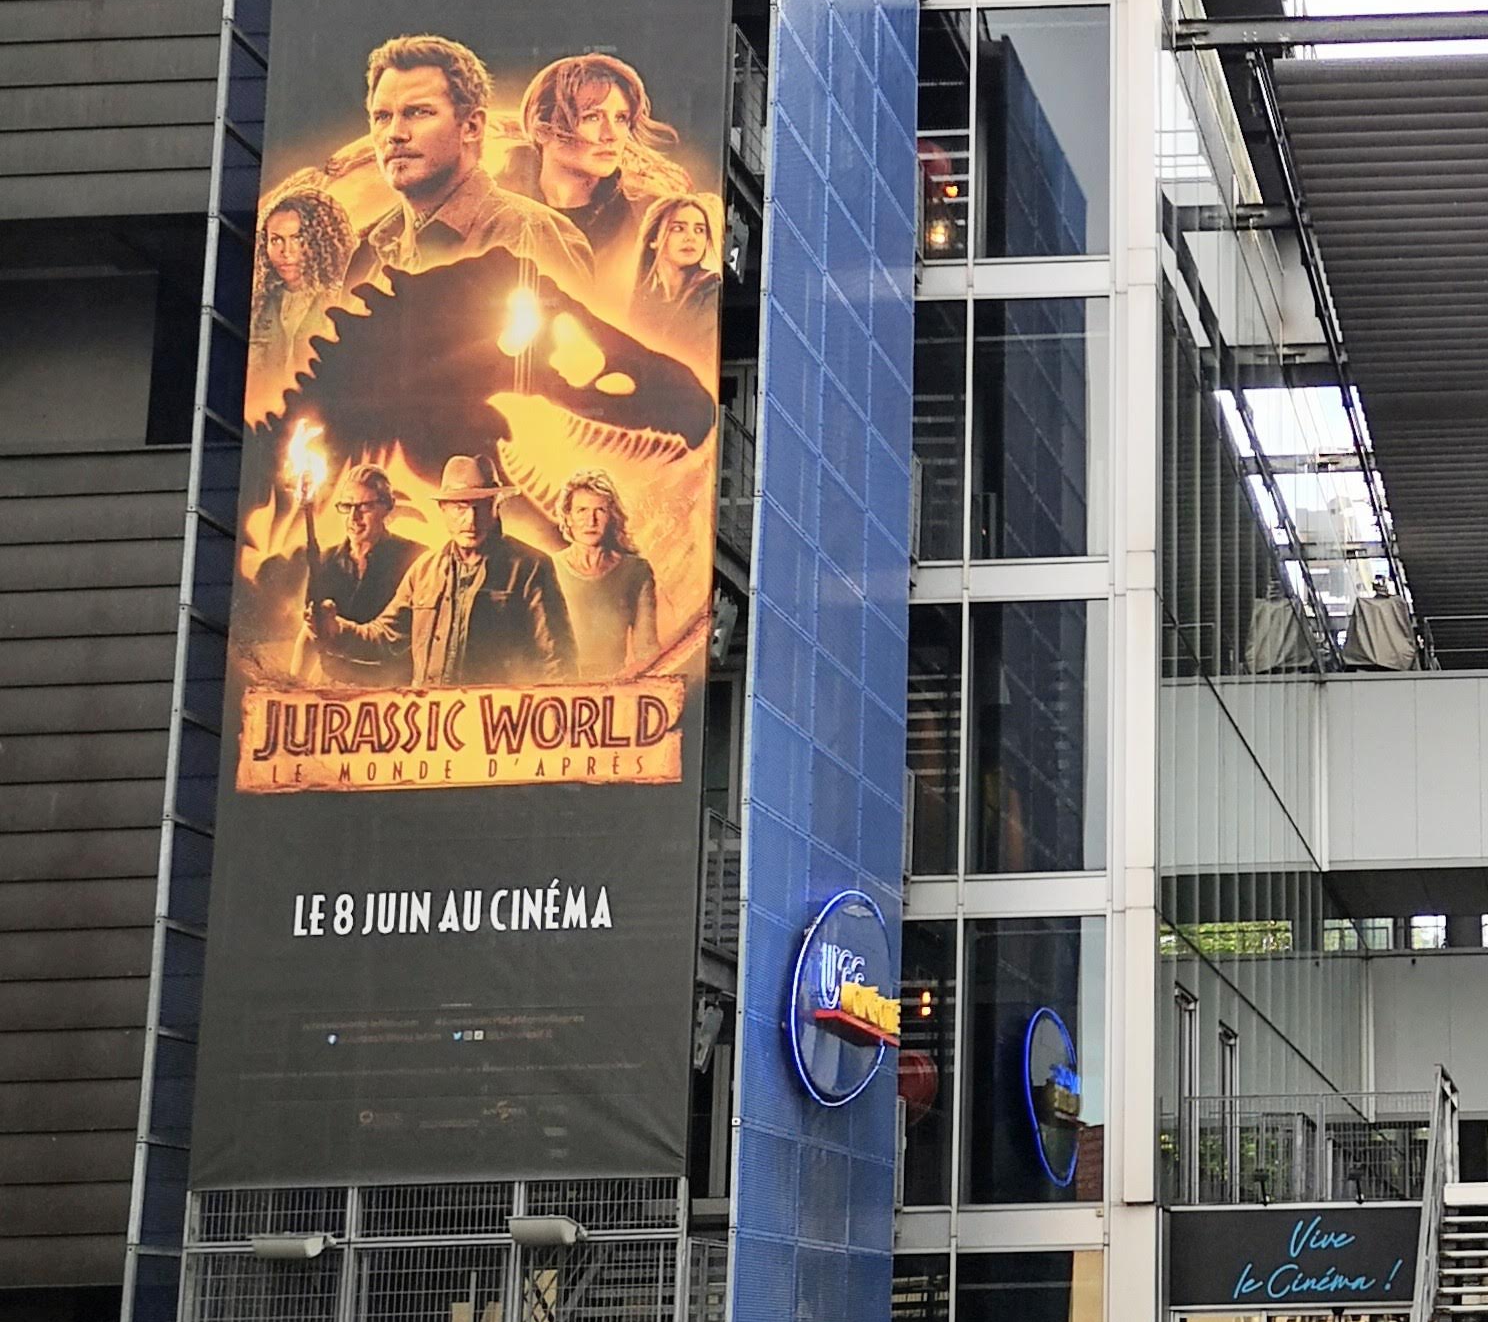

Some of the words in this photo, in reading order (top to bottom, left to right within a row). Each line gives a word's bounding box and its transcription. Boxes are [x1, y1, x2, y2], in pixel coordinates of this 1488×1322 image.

[252, 698, 467, 762] JURASSIC
[479, 693, 670, 756] WORLD
[271, 762, 304, 784] LE
[339, 760, 453, 782] MONDE
[487, 751, 645, 779] D'APRÈS
[292, 893, 327, 937] LE
[333, 892, 354, 935] 8
[361, 889, 432, 936] JUIN
[438, 887, 483, 933] AU
[489, 878, 614, 931] CINÉMA
[1289, 1215, 1356, 1258] Vive
[1232, 1263, 1263, 1300] le
[1267, 1263, 1376, 1299] Cinéma
[1383, 1258, 1403, 1292] !
